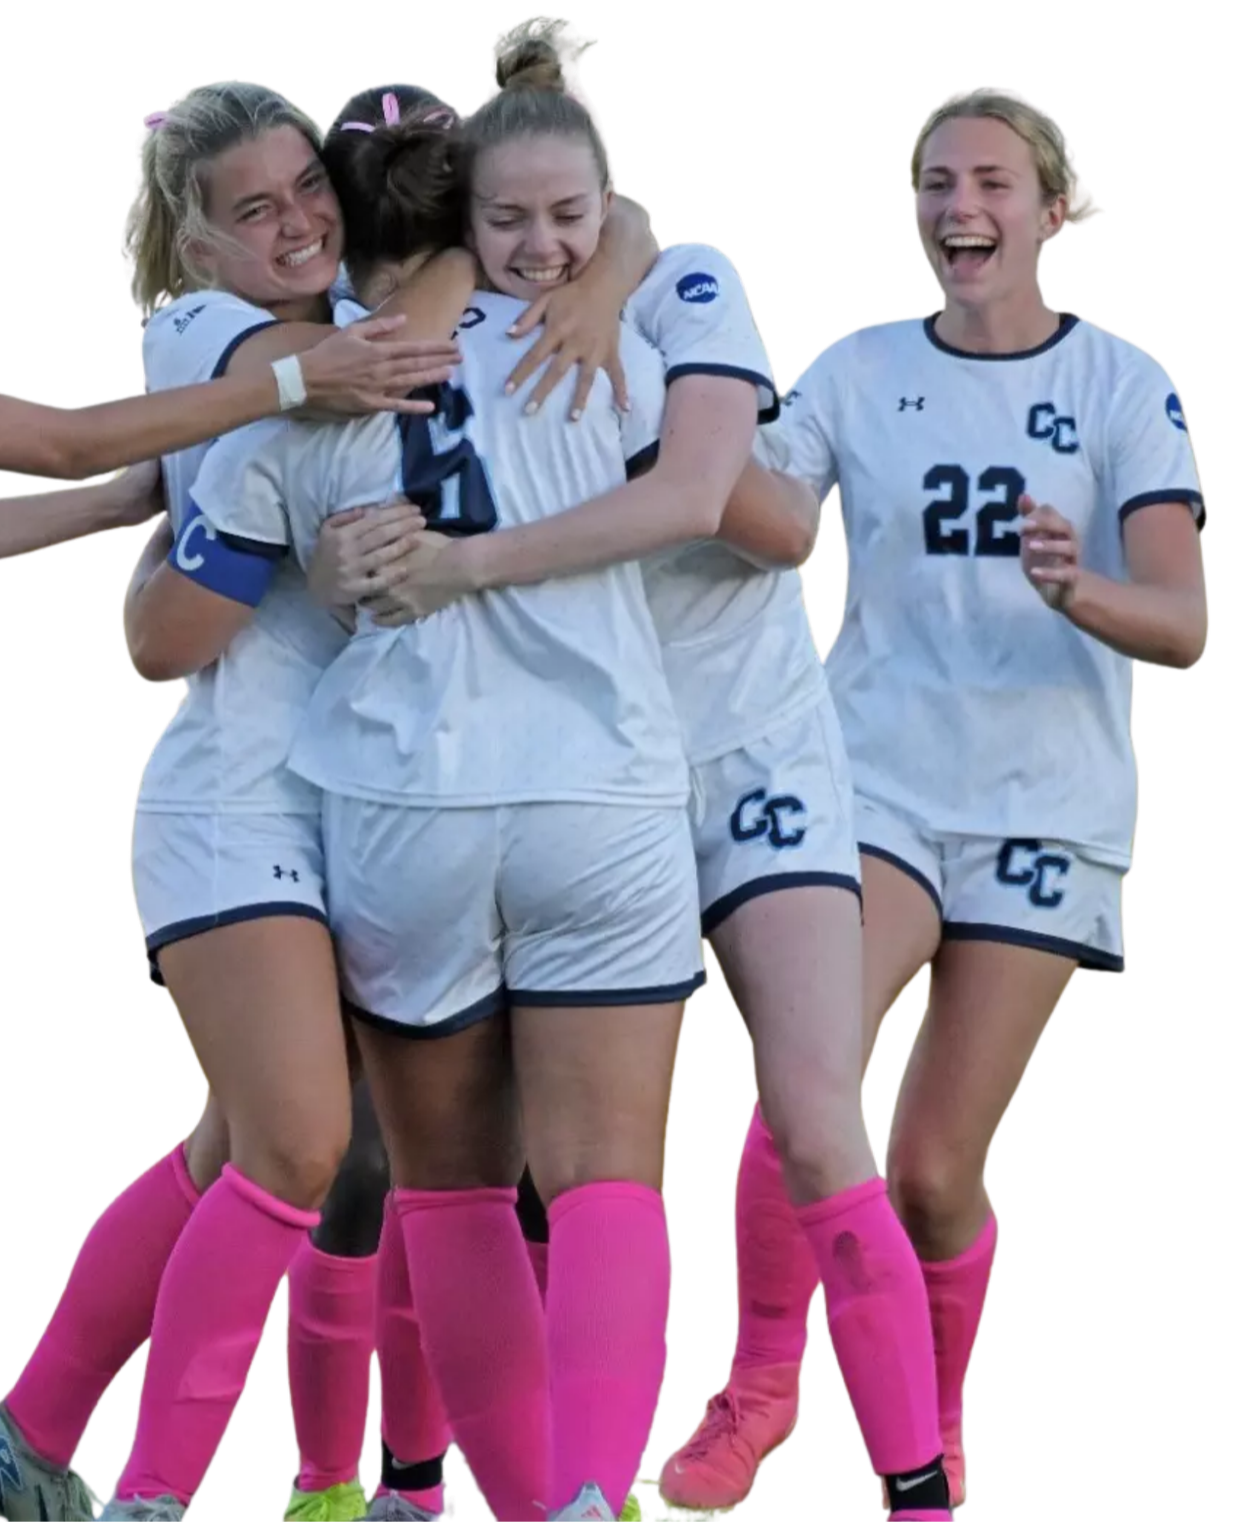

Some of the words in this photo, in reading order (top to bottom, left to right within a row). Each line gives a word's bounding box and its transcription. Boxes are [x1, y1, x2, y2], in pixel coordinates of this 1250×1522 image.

[683, 281, 718, 300] NCAA
[397, 380, 498, 534] 6
[1027, 402, 1079, 454] CC
[922, 464, 1026, 557] 22
[176, 514, 216, 571] C
[730, 787, 805, 848] CC
[996, 837, 1070, 907] CC
